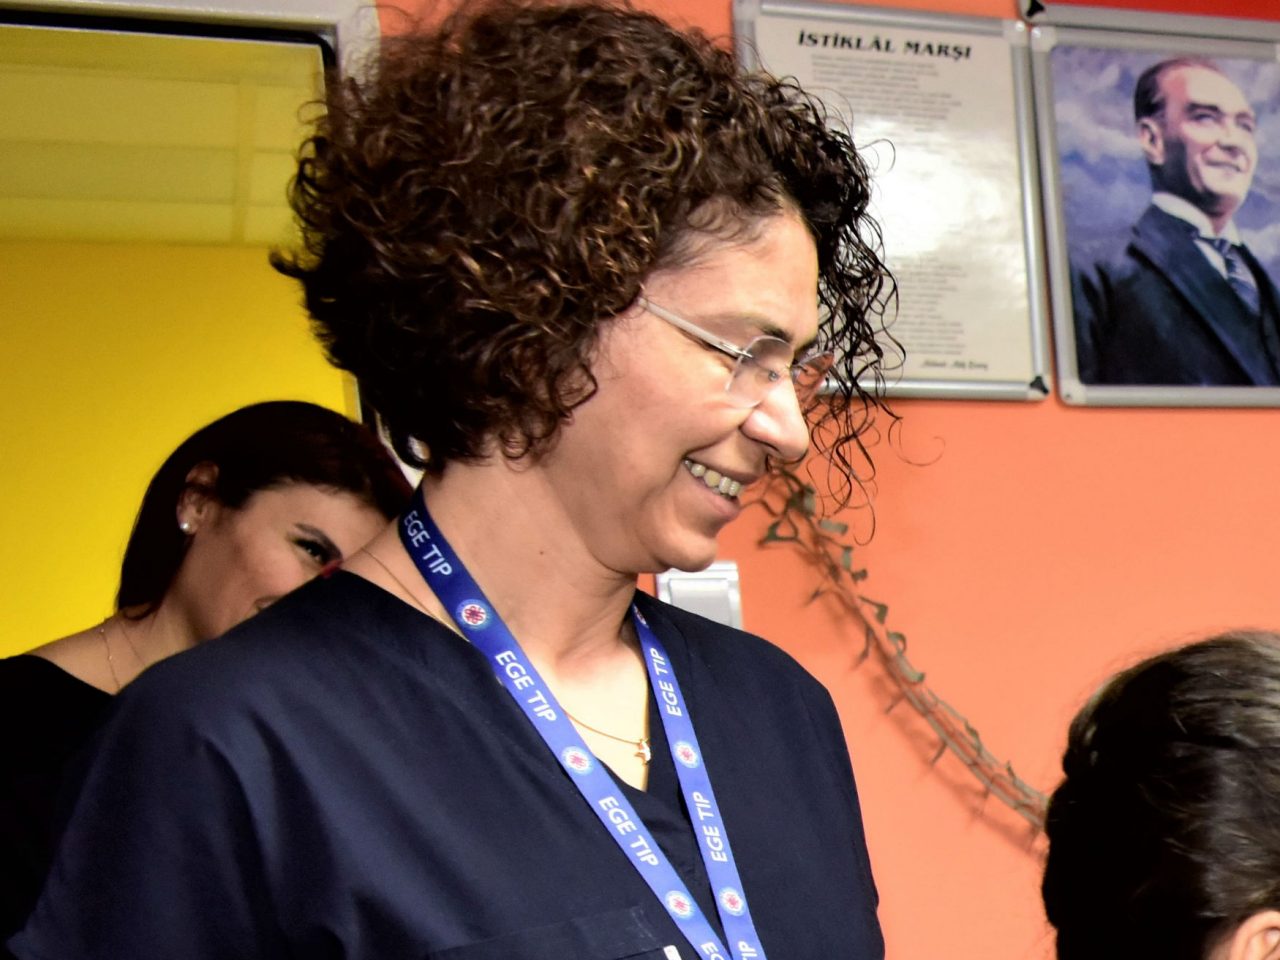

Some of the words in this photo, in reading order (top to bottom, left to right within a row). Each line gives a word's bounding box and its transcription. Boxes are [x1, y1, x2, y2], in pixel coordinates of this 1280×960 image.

[798, 29, 895, 53] İSTİKLÂL
[904, 41, 971, 61] MARŞI
[403, 509, 430, 548] EGE
[422, 544, 453, 577] TIP
[649, 647, 668, 675] TIP
[495, 650, 535, 690] EGE
[527, 690, 557, 722] TIP
[657, 681, 682, 717] EGE
[692, 791, 714, 819] TIP
[598, 795, 637, 836] EGE
[629, 835, 660, 867] TIP
[703, 825, 728, 863] EGE
